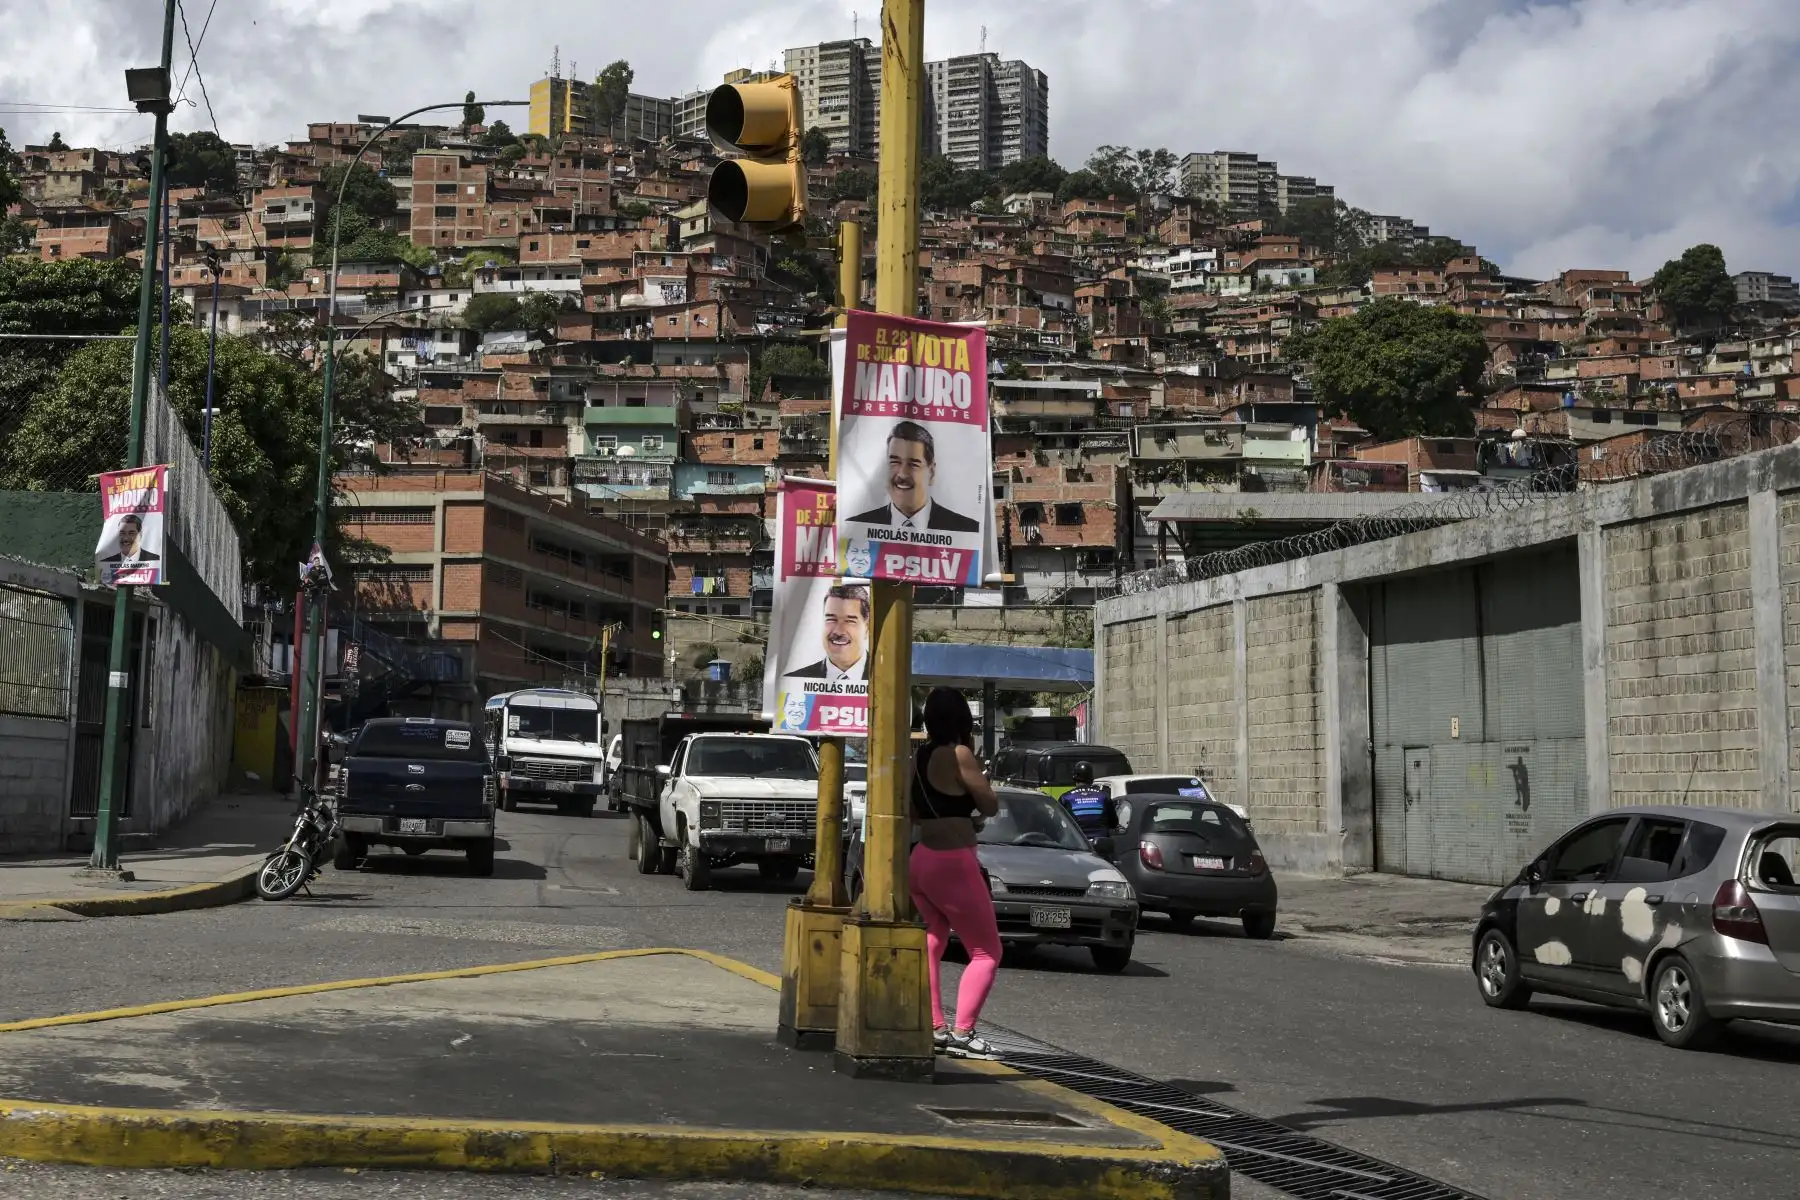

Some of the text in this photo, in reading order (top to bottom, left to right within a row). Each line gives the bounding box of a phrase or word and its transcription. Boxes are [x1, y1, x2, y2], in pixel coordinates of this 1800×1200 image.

[876, 328, 887, 344] EL
[857, 344, 908, 363] DE JULIO
[911, 331, 970, 371] VOTA
[853, 361, 971, 409] MADURO
[853, 402, 970, 419] PRESIDENTE
[816, 493, 829, 508] EL
[796, 509, 811, 525] DE
[795, 526, 835, 563] MA
[867, 528, 952, 546] NICOLÁS MADURO
[804, 682, 868, 694] NICOLÁS MAD
